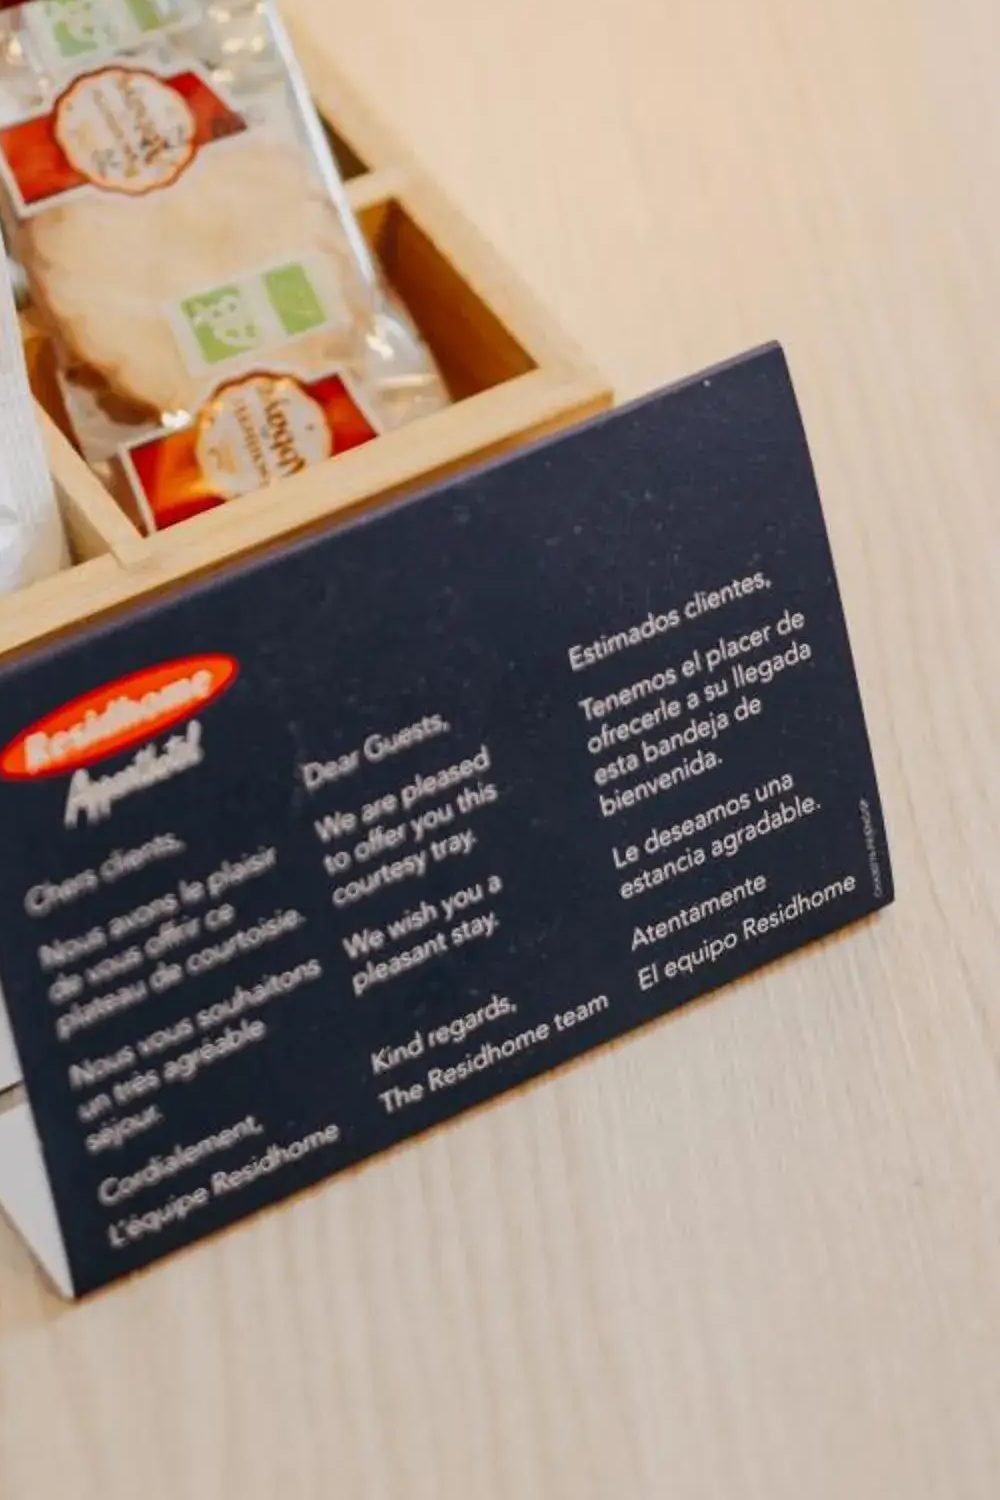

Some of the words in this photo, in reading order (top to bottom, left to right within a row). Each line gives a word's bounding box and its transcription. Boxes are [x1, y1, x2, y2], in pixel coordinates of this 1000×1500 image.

[568, 609, 681, 672] Estimados
[684, 571, 772, 618] clientes,
[578, 668, 677, 721] Tenemos
[681, 650, 701, 677] el
[706, 625, 771, 672] placer
[776, 610, 806, 636] de
[587, 698, 682, 754] ofrecerle
[687, 692, 700, 709] a
[704, 679, 728, 702] su
[732, 642, 812, 688] llegada
[594, 755, 640, 786] esta
[641, 711, 730, 763] bandeja
[734, 696, 762, 721] de
[302, 750, 360, 791] Dear
[363, 713, 450, 762] Guests,
[314, 812, 357, 843] We
[362, 794, 399, 825] are
[401, 744, 490, 809] pleased
[599, 750, 723, 817] bienvenida.
[324, 852, 351, 876] to
[354, 824, 406, 862] offer
[411, 803, 454, 842] you
[456, 781, 498, 814] this
[332, 850, 427, 908] courtesy
[431, 829, 478, 862] tray.
[612, 846, 639, 869] Le
[644, 793, 751, 853] deseamos
[755, 773, 794, 802] una
[620, 847, 707, 900] estancia
[711, 796, 822, 857] agradable.
[24, 868, 99, 917] Chers
[38, 926, 107, 970] Nous
[179, 880, 206, 904] le
[207, 846, 277, 898] plaisir
[342, 929, 385, 959] We
[387, 901, 438, 940] wish
[441, 884, 483, 920] you
[488, 875, 502, 894] a
[632, 874, 767, 951] Atentamente
[637, 963, 659, 992] El
[665, 932, 738, 978] equipo
[742, 875, 857, 940] Residhome
[49, 972, 83, 1004] de
[205, 903, 235, 931] ce
[56, 980, 148, 1040] plateau
[150, 961, 183, 993] de
[186, 908, 306, 976] courtoisie.
[352, 932, 448, 996] pleasant
[451, 912, 500, 946] stay.
[68, 1045, 136, 1090] Nous
[136, 1018, 194, 1058] vous
[196, 959, 322, 1030] souhaitons
[370, 1030, 425, 1073] Kind
[428, 994, 518, 1044] regards,
[378, 1084, 424, 1114] The
[427, 1023, 549, 1091] Residhome
[553, 993, 610, 1032] team
[78, 1093, 112, 1122] un
[98, 1115, 264, 1205] Cordialement,
[211, 1124, 340, 1196] Residhome
